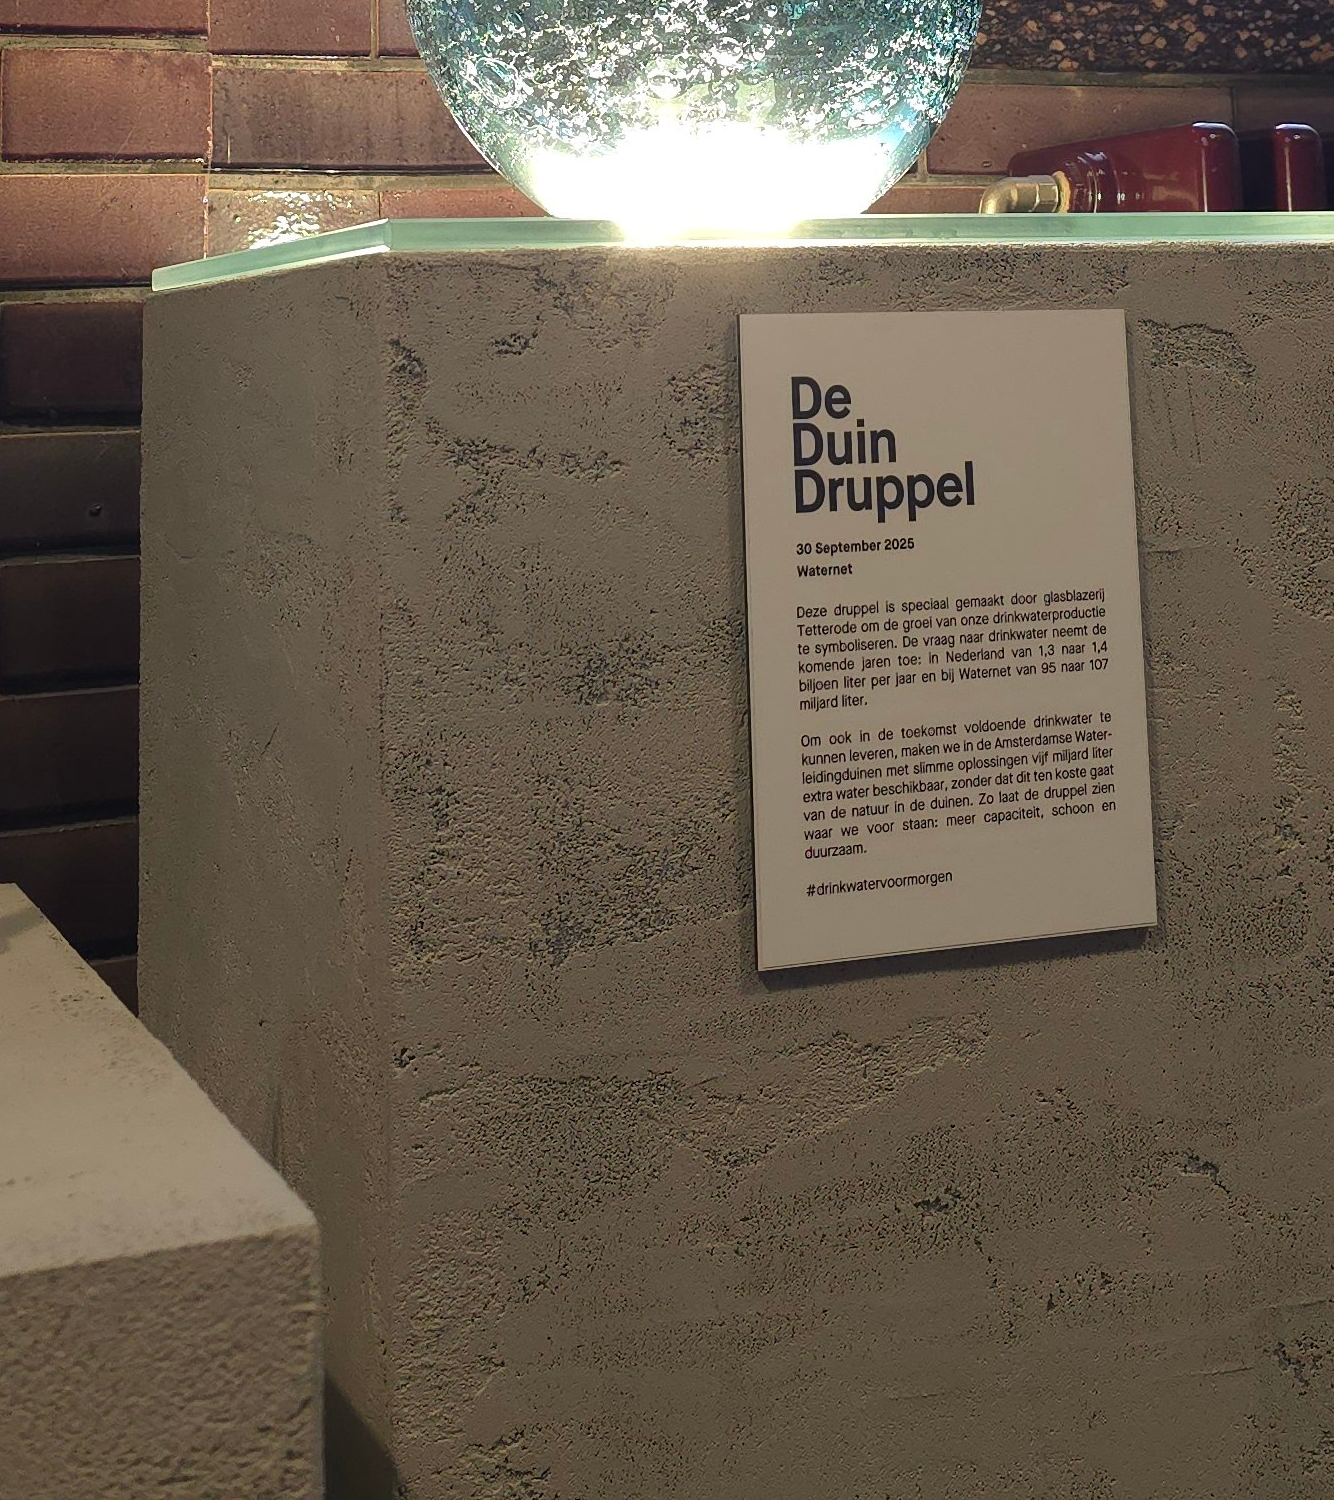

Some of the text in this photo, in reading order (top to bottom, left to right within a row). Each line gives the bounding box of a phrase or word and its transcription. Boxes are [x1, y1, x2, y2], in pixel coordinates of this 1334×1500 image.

[790, 376, 852, 420] De
[792, 418, 897, 467] Duin
[794, 460, 975, 524] Druppel
[796, 537, 915, 557] 30 September 2025
[796, 563, 853, 578] Waternet
[796, 587, 1105, 619] Deze druppel is speciaal gemaakt door glasblazerij
[796, 605, 1106, 637] Tetterode om de groei van onze drinkwaterproductie
[797, 623, 1107, 658] te symboliseren. De vraag naar drinkwater neemt de
[798, 640, 1108, 674] komende jaren toe: in Nederland van 1,3 naar 1,4
[798, 658, 1109, 694] biljoen liter per jaar en bij Waternet van 95 naar 107
[799, 694, 868, 713] miljard liter.
[800, 711, 1112, 748] Om ook in de toekomst voldoende drinkwater te
[801, 729, 1113, 767] kunnen leveren, maken we in de Amsterdamse Water-
[802, 746, 1113, 786] leidingduinen met slimme oplossingen vijf miljard liter
[802, 763, 1115, 803] extra water beschikbaar, zonder dat dit ten koste gaat
[803, 781, 1115, 822] van de natuur in de duinen. Zo laat de druppel zien
[803, 801, 1117, 841] waar we voor staan: meer capaciteit, schoon en
[804, 843, 868, 860] duurzaam.
[806, 871, 953, 897] #drinkwatervoormorgen
